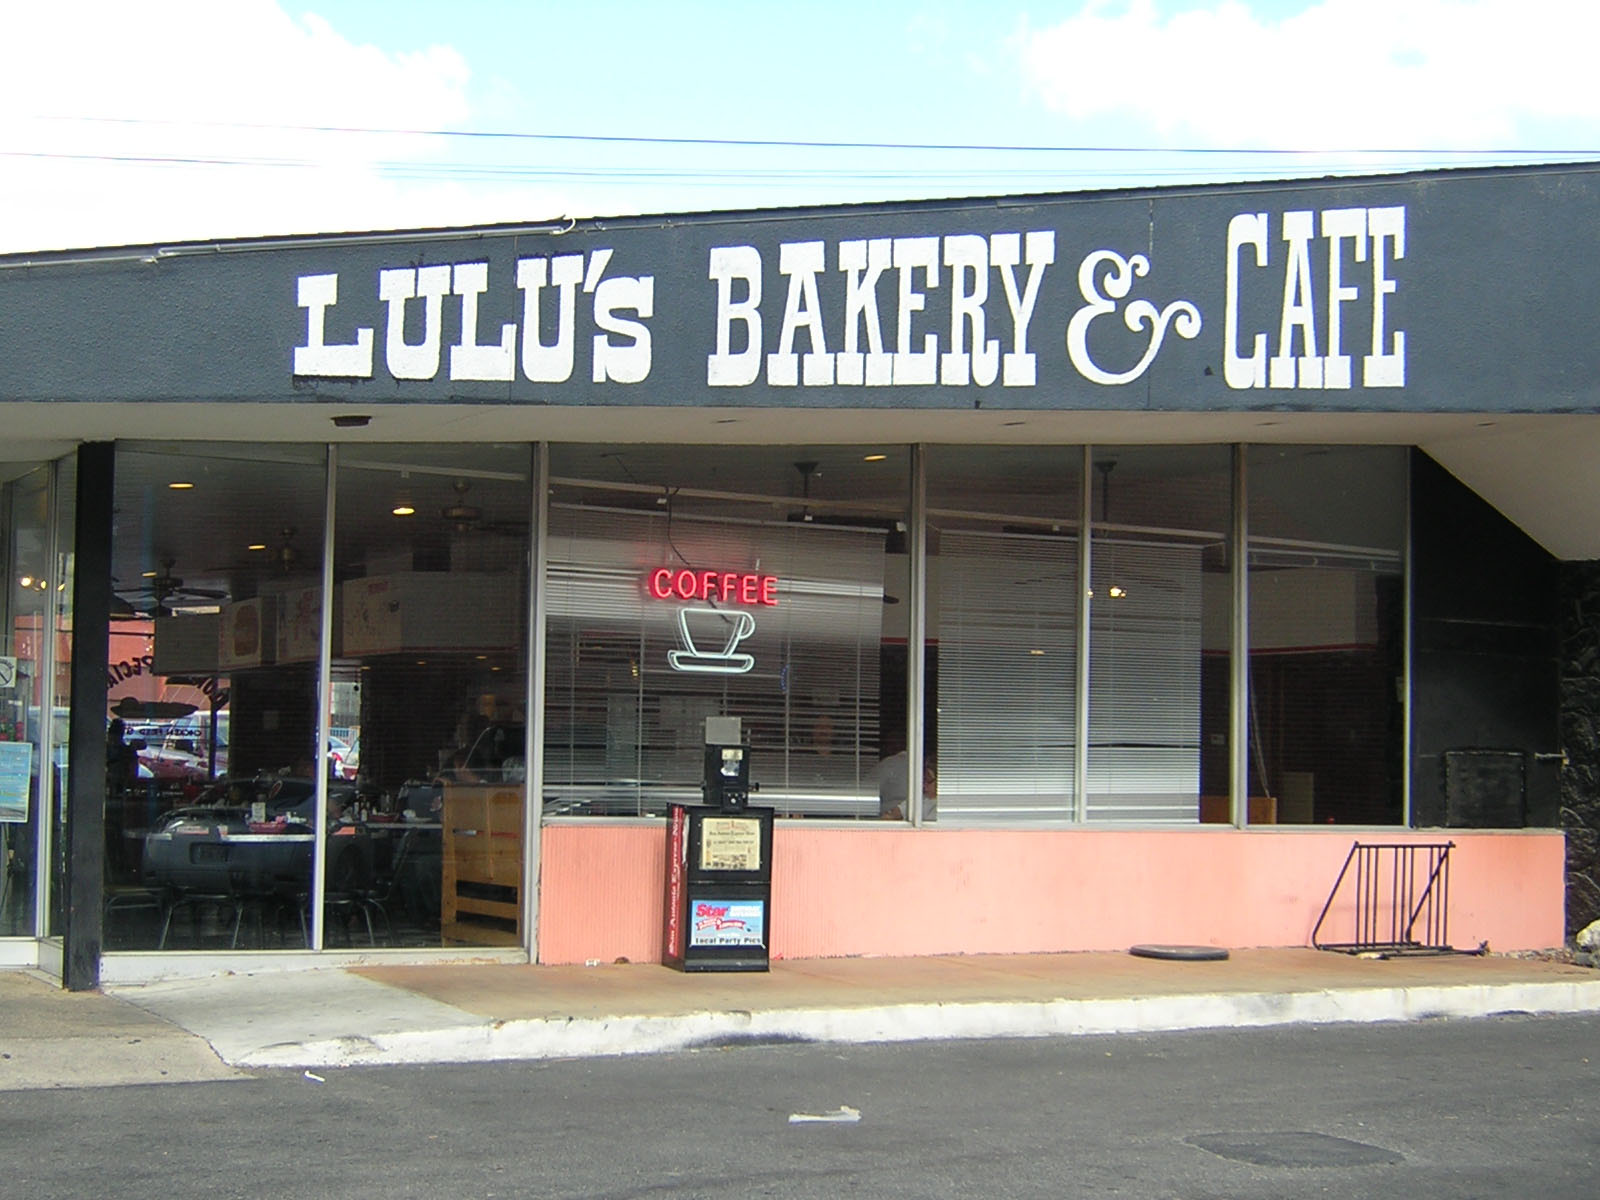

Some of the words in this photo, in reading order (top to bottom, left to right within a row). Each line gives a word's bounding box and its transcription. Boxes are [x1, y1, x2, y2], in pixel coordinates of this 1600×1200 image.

[708, 231, 1055, 387] BAKERY
[1067, 250, 1202, 386] &
[1224, 207, 1406, 389] CAFE
[651, 568, 778, 605] COFFEE
[696, 903, 728, 917] Star
[719, 937, 741, 945] Party
